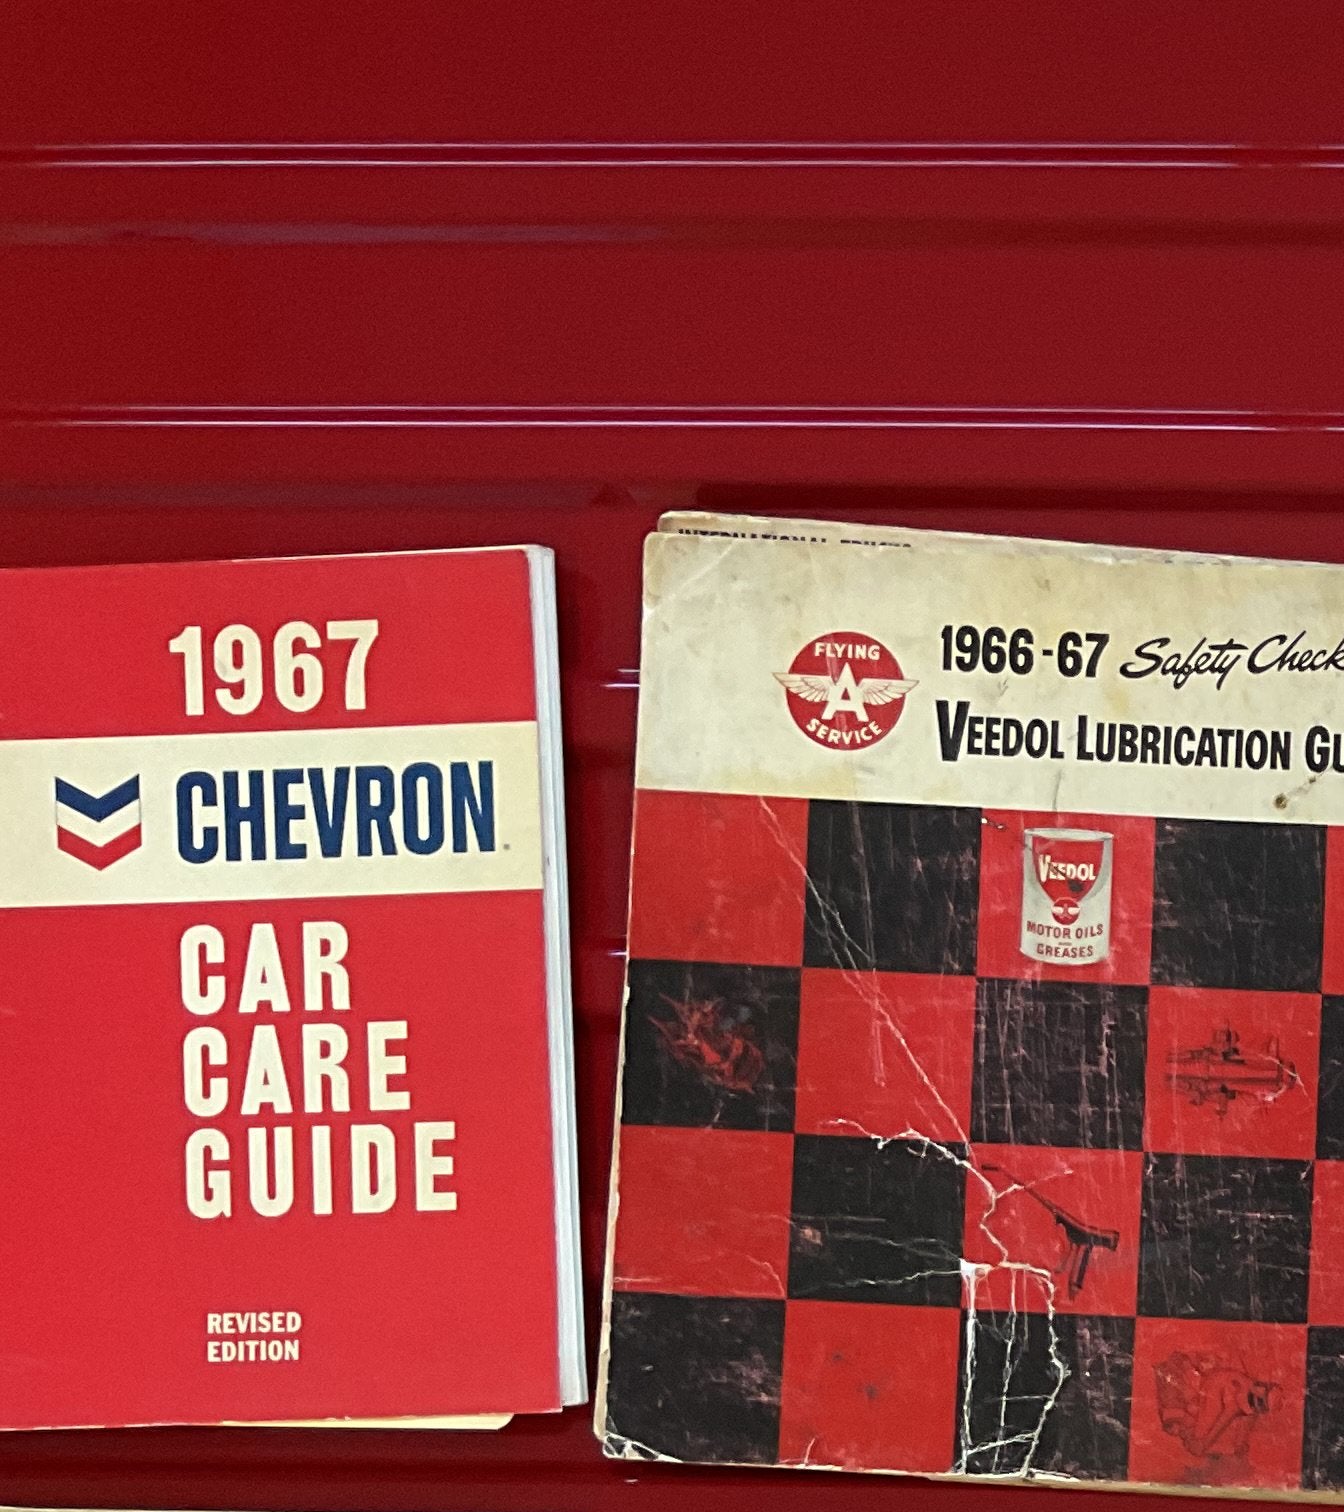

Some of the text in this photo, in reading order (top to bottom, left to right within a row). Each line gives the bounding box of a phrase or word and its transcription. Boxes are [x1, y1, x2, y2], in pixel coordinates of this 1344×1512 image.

[170, 619, 379, 717] 1967
[814, 641, 881, 661] FLYING
[941, 625, 1110, 678] 1966-67
[1120, 636, 1247, 691] Safety
[820, 662, 869, 722] A
[806, 718, 883, 745] SERVICE
[936, 700, 1065, 762] VEEDOL
[1077, 714, 1291, 770] LUBRICATION
[175, 761, 496, 864] CHEVRON
[1037, 854, 1096, 882] VEEDOL
[1026, 921, 1104, 941] MOTOR OILS
[1036, 943, 1094, 960] GREASES
[180, 921, 351, 1015] CAR
[183, 1020, 411, 1117] CARE
[185, 1121, 457, 1218] GUIDE
[207, 1311, 302, 1333] REVISED
[207, 1339, 300, 1362] EDITION
